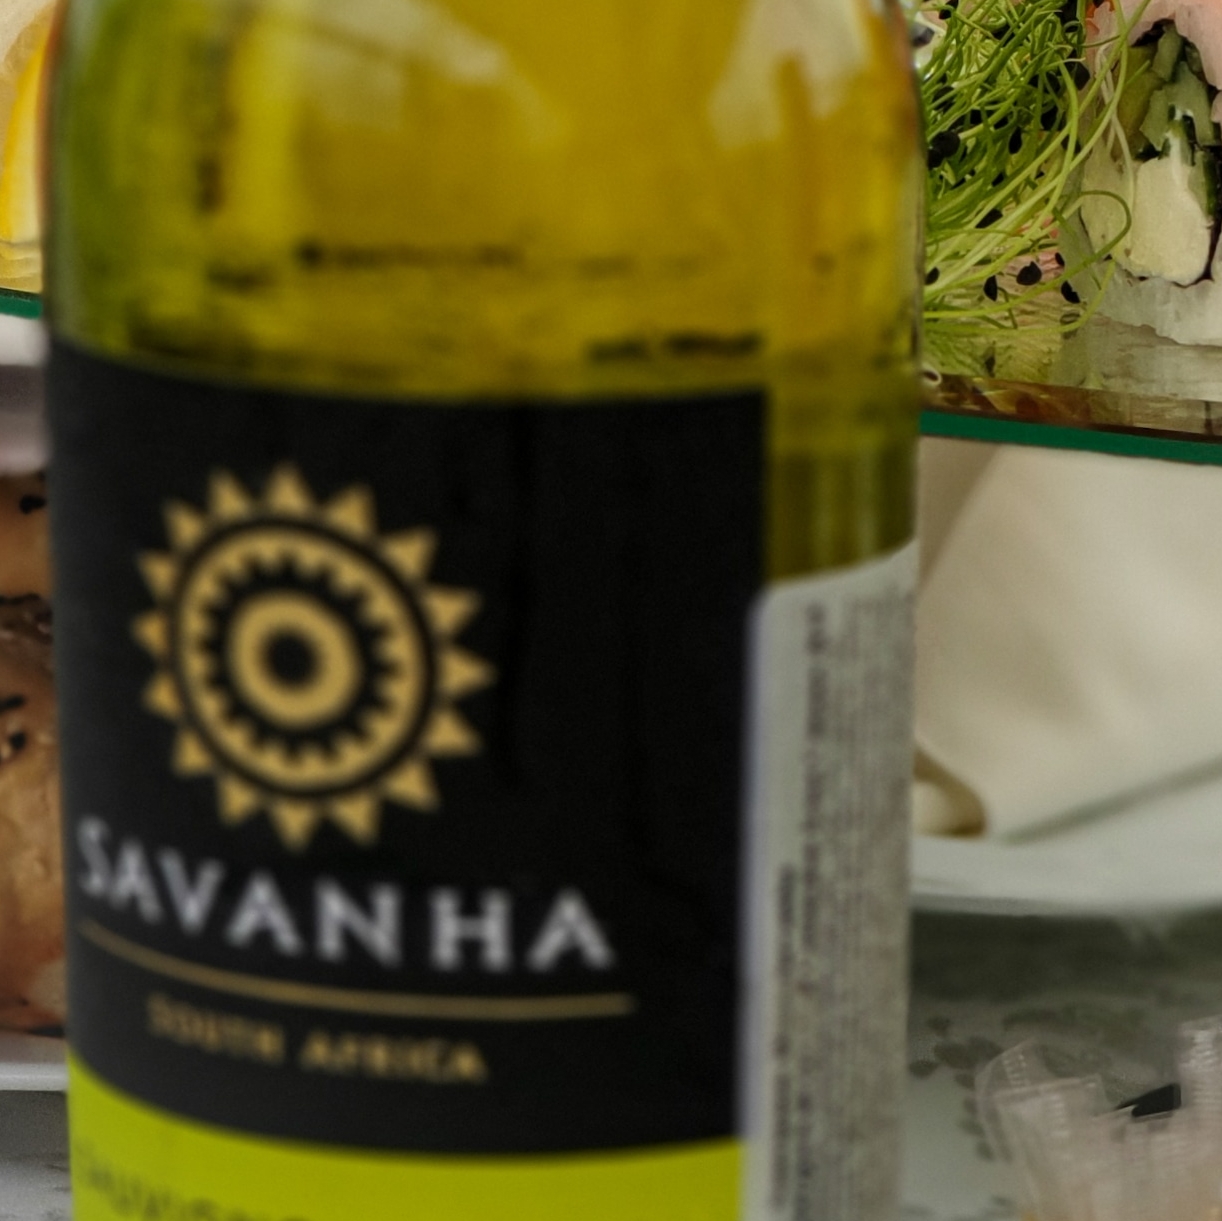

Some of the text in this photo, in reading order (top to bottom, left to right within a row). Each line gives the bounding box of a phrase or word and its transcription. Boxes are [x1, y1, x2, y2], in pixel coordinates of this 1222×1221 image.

[77, 815, 615, 970] SAVANHA
[148, 992, 488, 1083] SOUTH AFRICA
